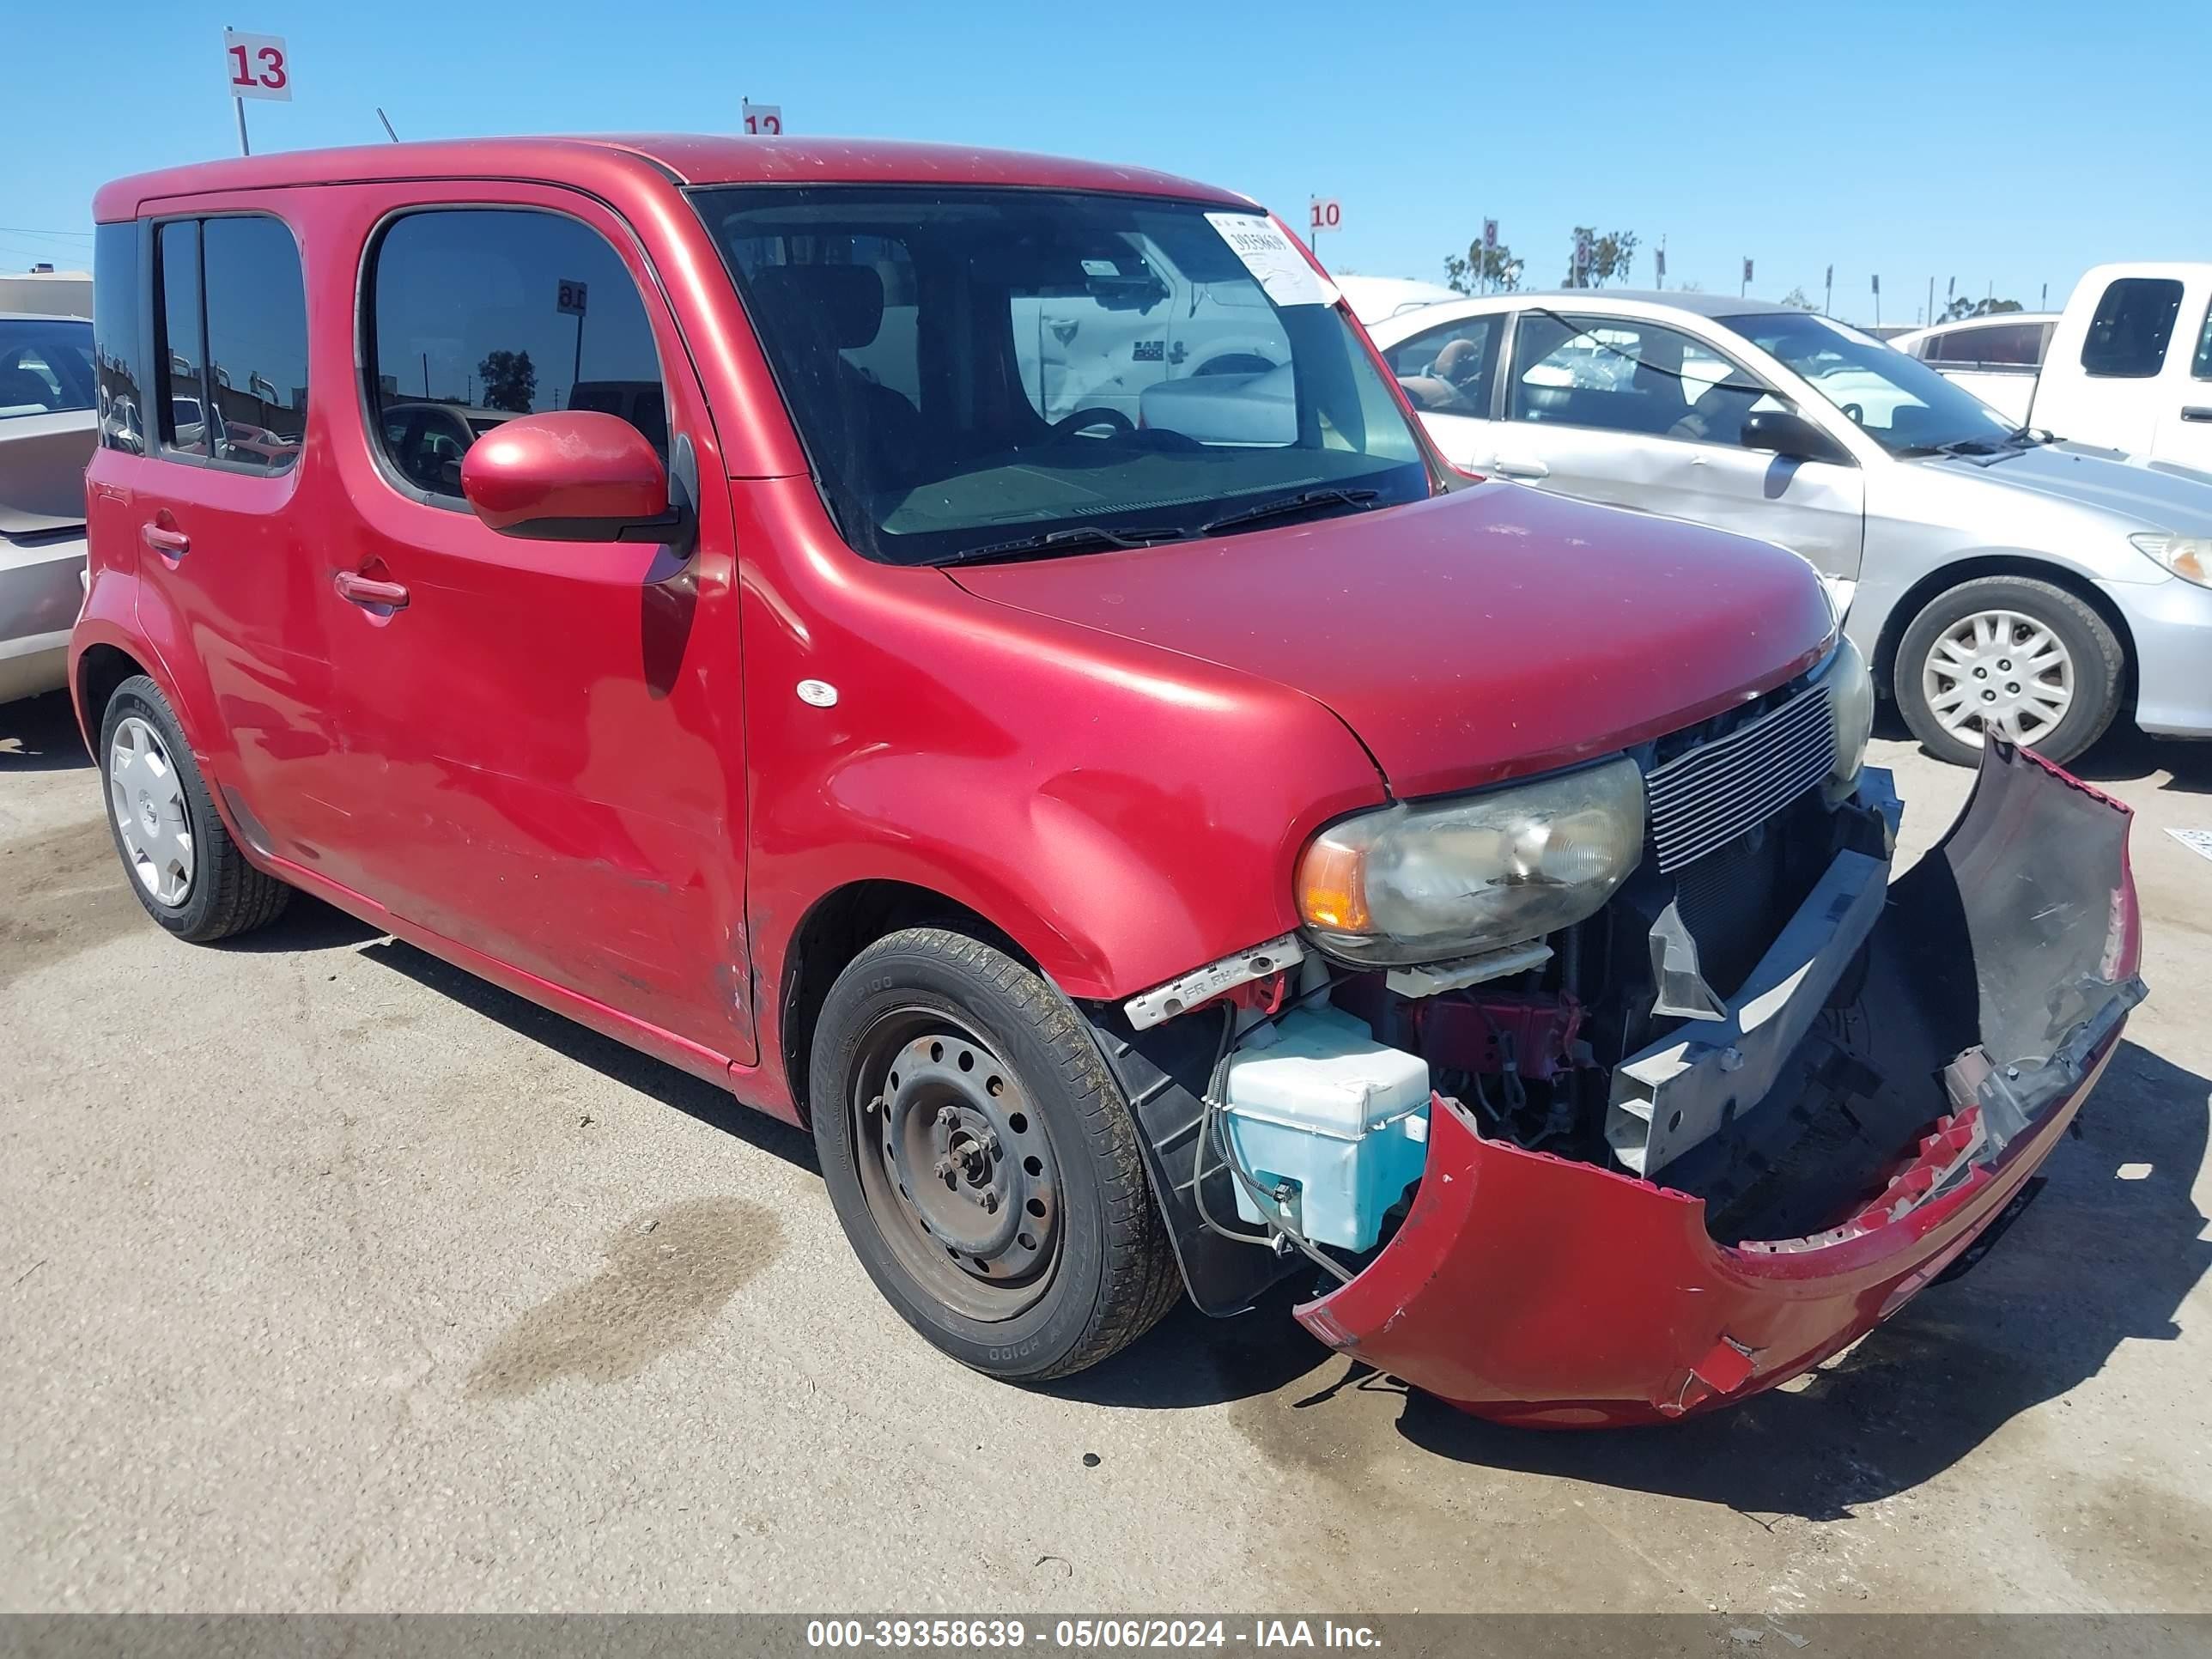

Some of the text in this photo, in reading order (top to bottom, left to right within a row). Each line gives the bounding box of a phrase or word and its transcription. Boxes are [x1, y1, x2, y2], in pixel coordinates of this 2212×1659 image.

[228, 45, 287, 89] 13
[745, 115, 780, 135] 12
[1311, 204, 1340, 227] 10
[1231, 233, 1287, 251] 39358639
[1486, 223, 1495, 247] 9
[1578, 241, 1587, 263] 8
[1183, 969, 1233, 1001] FR RH
